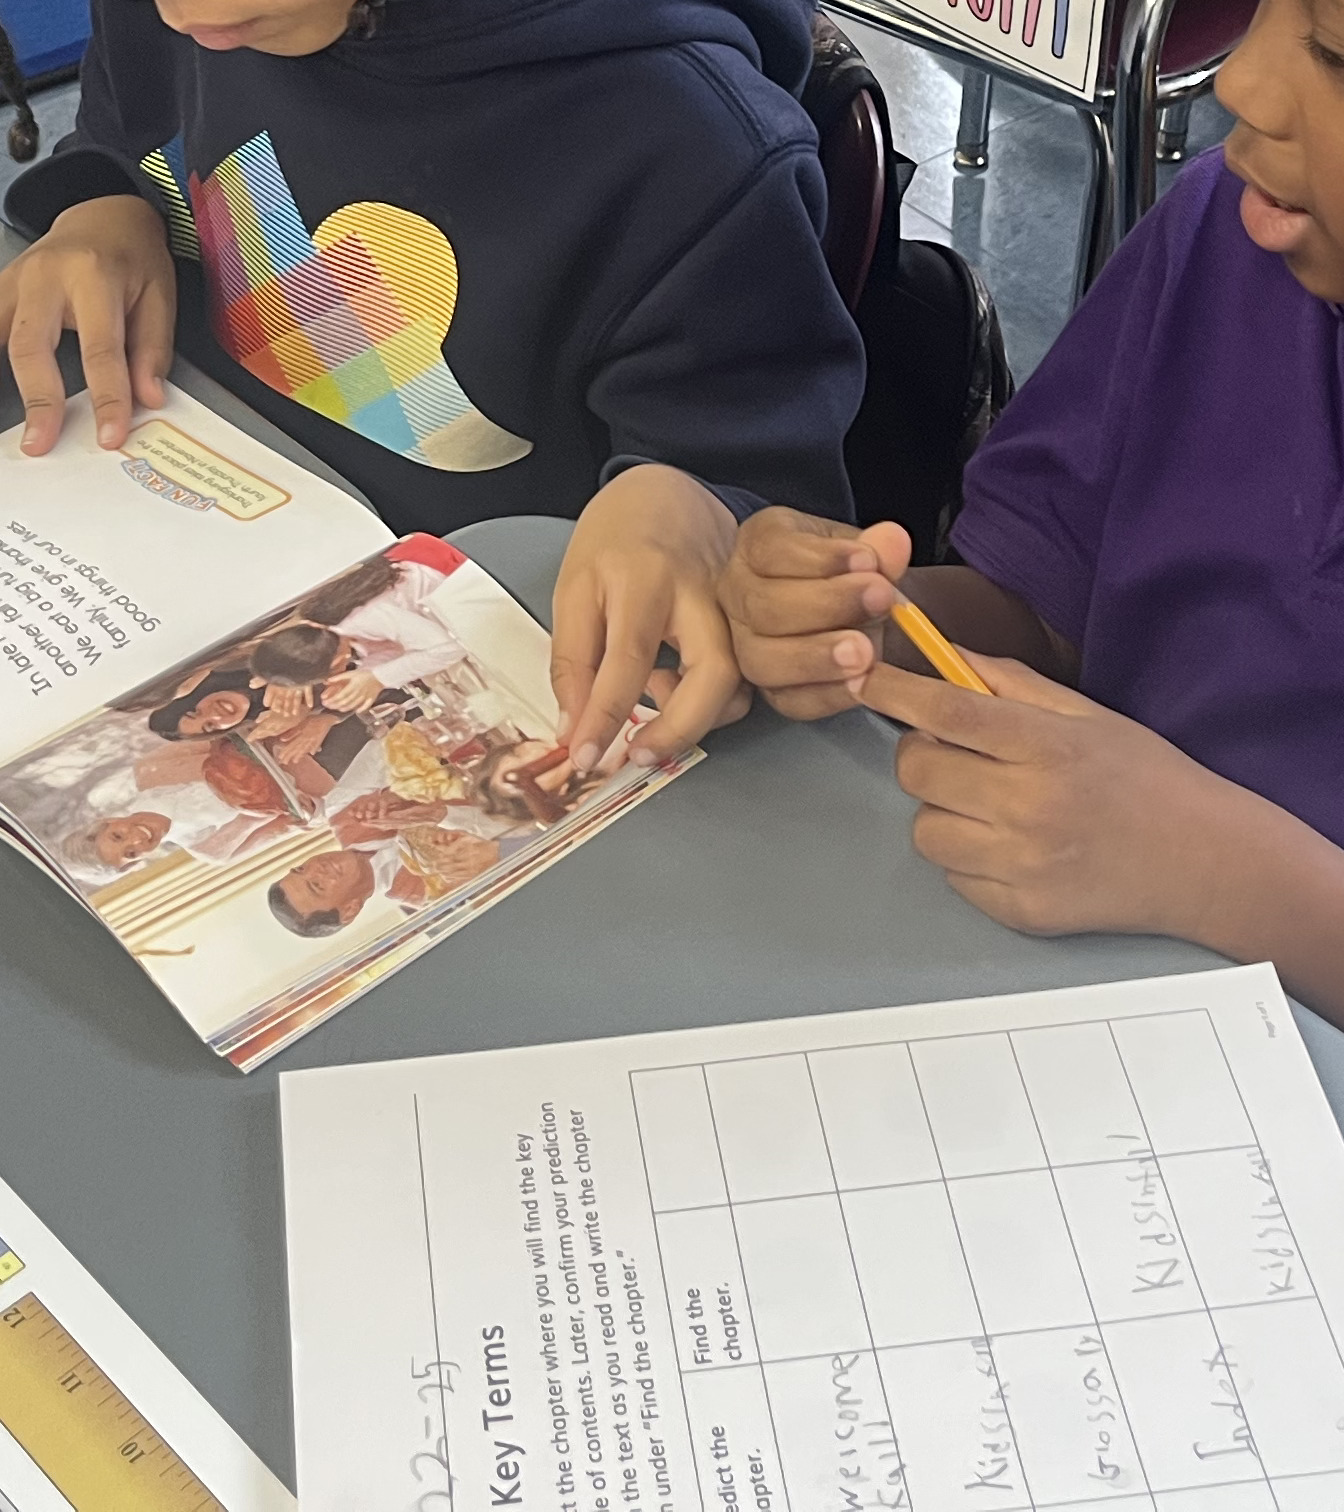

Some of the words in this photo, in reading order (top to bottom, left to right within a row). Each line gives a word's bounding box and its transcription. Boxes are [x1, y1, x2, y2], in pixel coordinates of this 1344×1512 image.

[34, 541, 62, 556] our
[31, 565, 68, 585] give
[74, 564, 117, 596] things
[14, 582, 42, 604] big
[60, 585, 85, 608] We
[48, 612, 78, 634] eat
[109, 595, 161, 632] good
[3, 644, 33, 673] late
[19, 624, 77, 676] another
[77, 636, 102, 666] We
[30, 671, 52, 696] In
[516, 1134, 534, 1162] key
[541, 1102, 568, 1185] prediction
[570, 1110, 591, 1173] chapter
[519, 1167, 536, 1194] the
[579, 1179, 596, 1206] the
[521, 1200, 541, 1233] find
[553, 1191, 575, 1229] your
[584, 1212, 603, 1256] write
[526, 1238, 546, 1268] will
[558, 1234, 581, 1305] confirm
[535, 1274, 555, 1308] you
[588, 1262, 609, 1297] and
[3, 1307, 28, 1330] 12
[686, 1289, 703, 1319] the
[570, 1310, 589, 1364] Later,
[594, 1304, 617, 1346] read
[717, 1283, 742, 1360] chapter.
[540, 1314, 559, 1371] where
[633, 1341, 651, 1372] the
[689, 1325, 712, 1364] Find
[57, 1371, 80, 1395] 11
[482, 1326, 513, 1431] Terms
[606, 1352, 628, 1387] you
[547, 1378, 570, 1454] chapter
[578, 1371, 602, 1463] contents.
[612, 1393, 627, 1416] as
[117, 1439, 146, 1465] 10
[613, 1422, 634, 1462] text
[710, 1427, 729, 1460] the
[490, 1441, 526, 1506] Key
[556, 1461, 574, 1495] the
[586, 1471, 606, 1490] of
[648, 1437, 671, 1496] under
[621, 1469, 640, 1502] the
